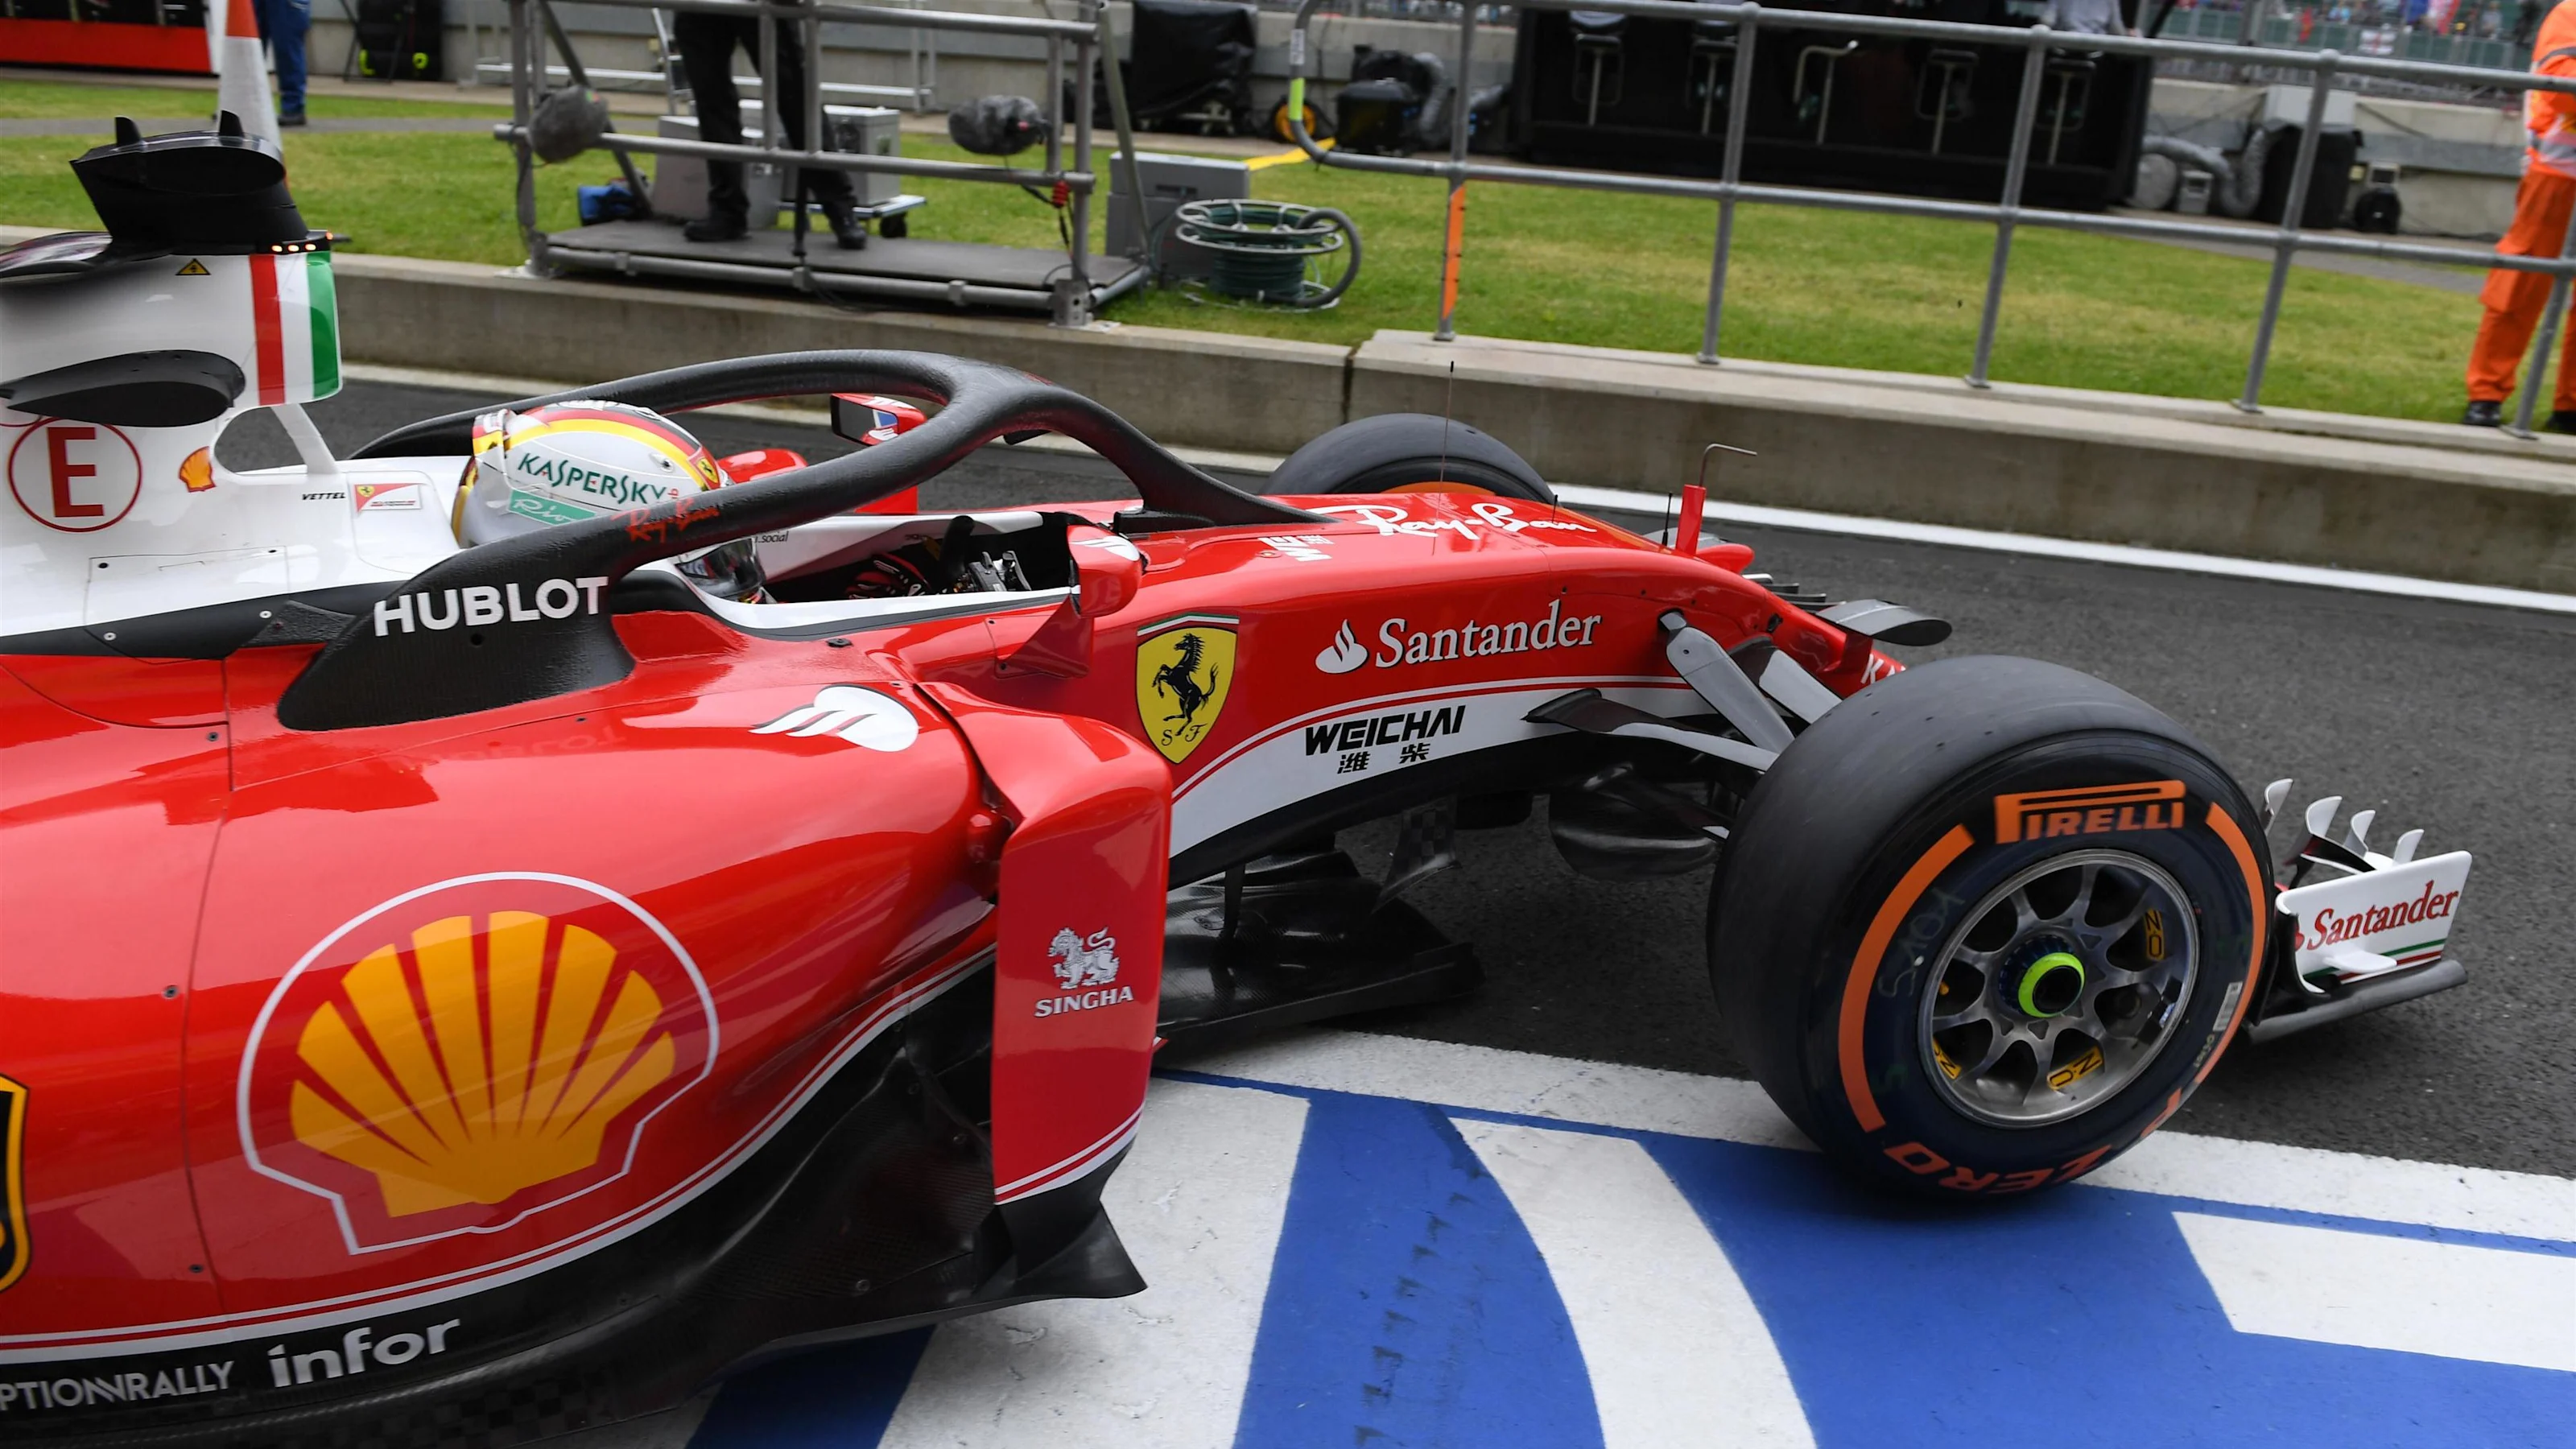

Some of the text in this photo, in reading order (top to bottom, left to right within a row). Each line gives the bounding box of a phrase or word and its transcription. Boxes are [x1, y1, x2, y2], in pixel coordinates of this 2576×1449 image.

[47, 427, 104, 518] E
[302, 491, 346, 501] VETTEL
[518, 452, 667, 505] KASPERSKY
[1306, 503, 1598, 540] Ray-Ban
[373, 576, 609, 637] HUBLOT
[1375, 599, 1602, 668] Santander
[1306, 705, 1465, 755] WEICHAI
[1994, 779, 2186, 844] PIRELLI
[2307, 880, 2459, 952] Santander
[1034, 985, 1133, 1018] SINGHA
[1884, 1141, 2112, 1194] ZERO
[268, 1318, 460, 1388] infor
